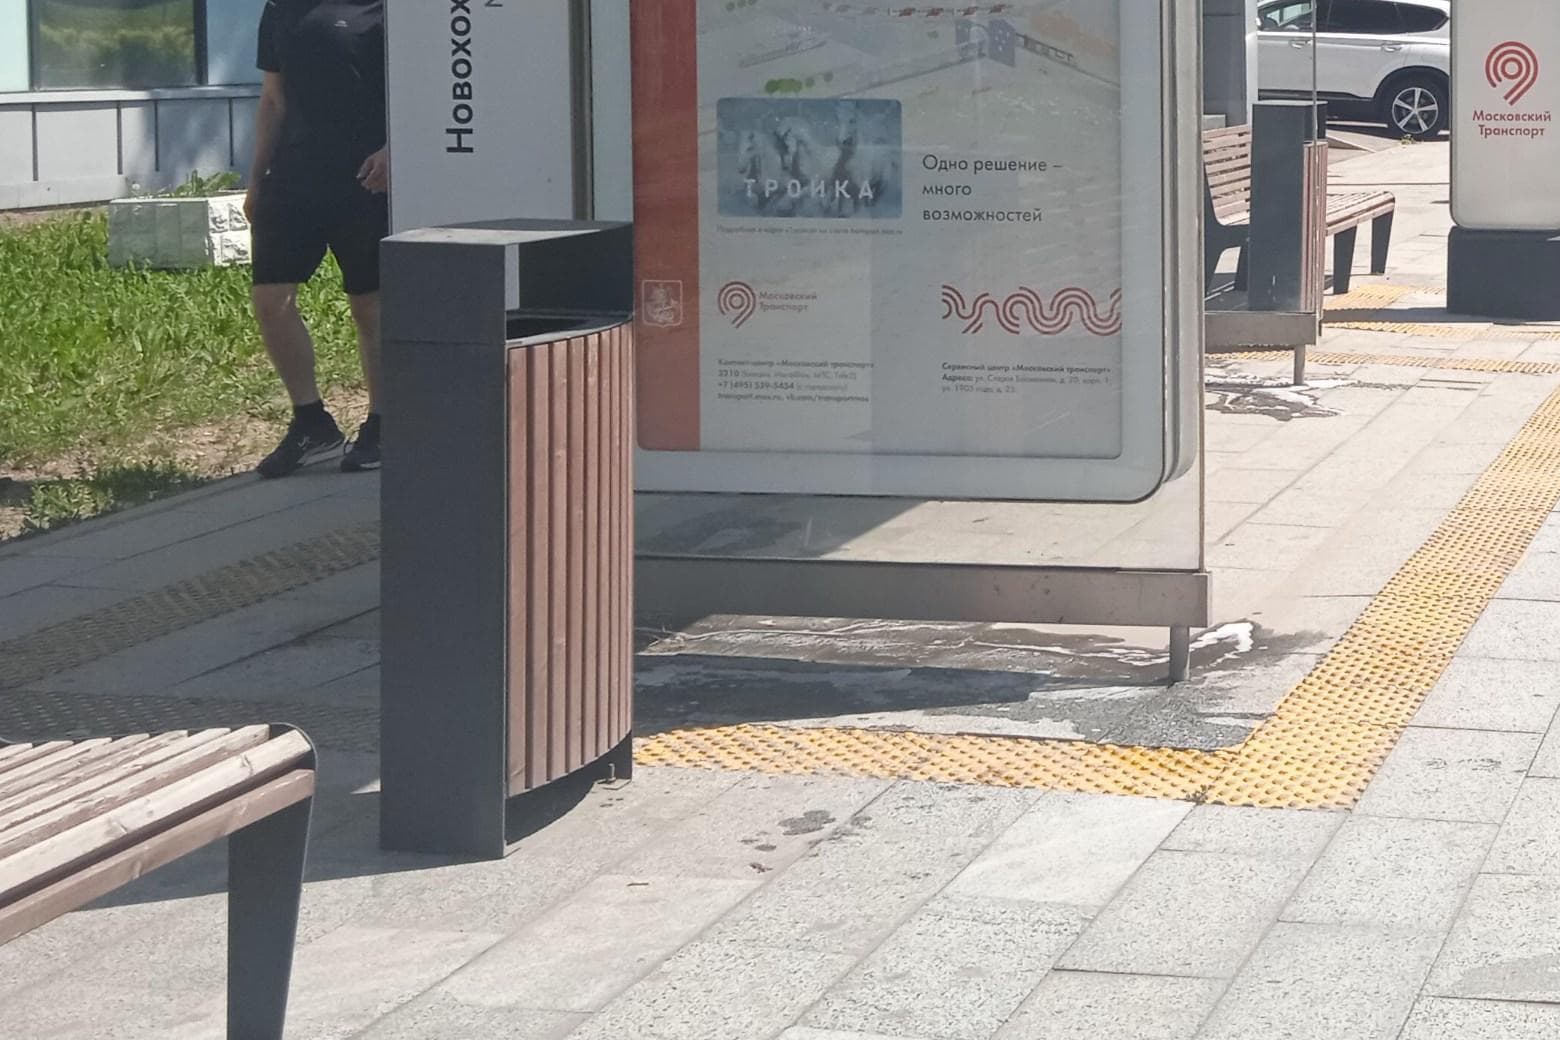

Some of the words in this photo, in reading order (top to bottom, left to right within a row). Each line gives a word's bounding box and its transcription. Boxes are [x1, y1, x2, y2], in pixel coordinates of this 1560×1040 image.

[1472, 109, 1552, 122] Московский
[1478, 124, 1545, 138] Транспорт
[922, 154, 968, 172] Одно
[973, 160, 1047, 174] решение
[922, 185, 972, 196] много
[922, 208, 1042, 222] возможностей
[759, 291, 818, 300] Московский
[759, 302, 808, 312] Транспорт
